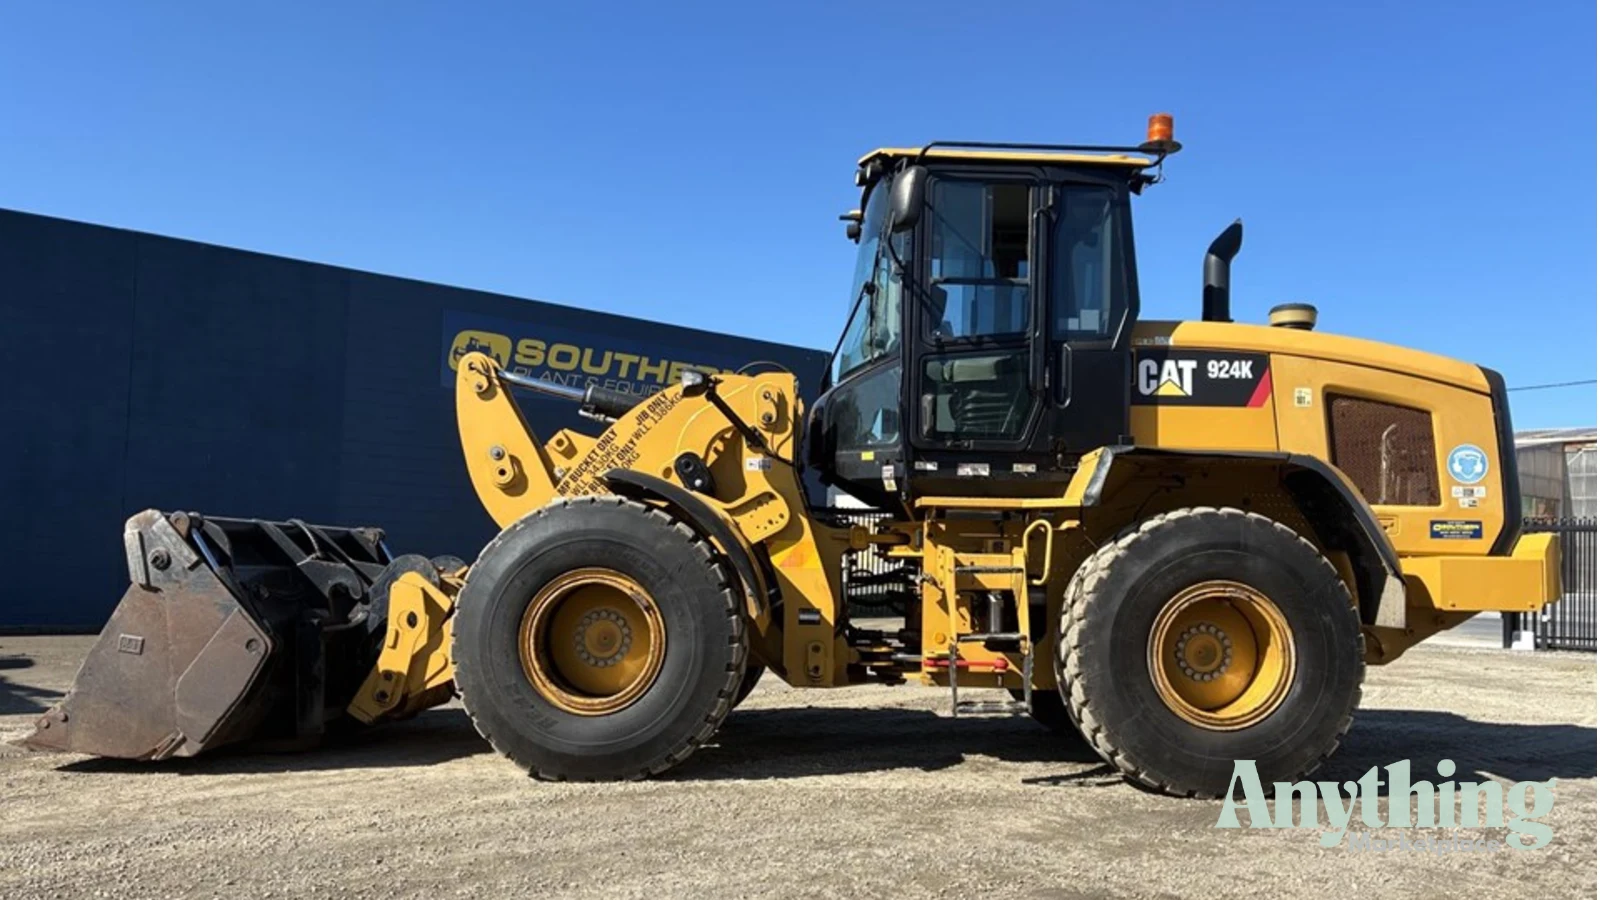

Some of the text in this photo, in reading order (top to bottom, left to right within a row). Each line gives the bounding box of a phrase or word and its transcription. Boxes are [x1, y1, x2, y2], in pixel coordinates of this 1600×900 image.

[515, 337, 749, 387] SOUTHE
[1138, 359, 1253, 396] CAT 924K
[635, 391, 668, 426] JIB ONLY
[616, 438, 637, 461] ONLY
[632, 424, 652, 440] WLL
[569, 449, 600, 482] BUCKET
[596, 428, 618, 452] ONLY
[570, 479, 589, 497] WLL
